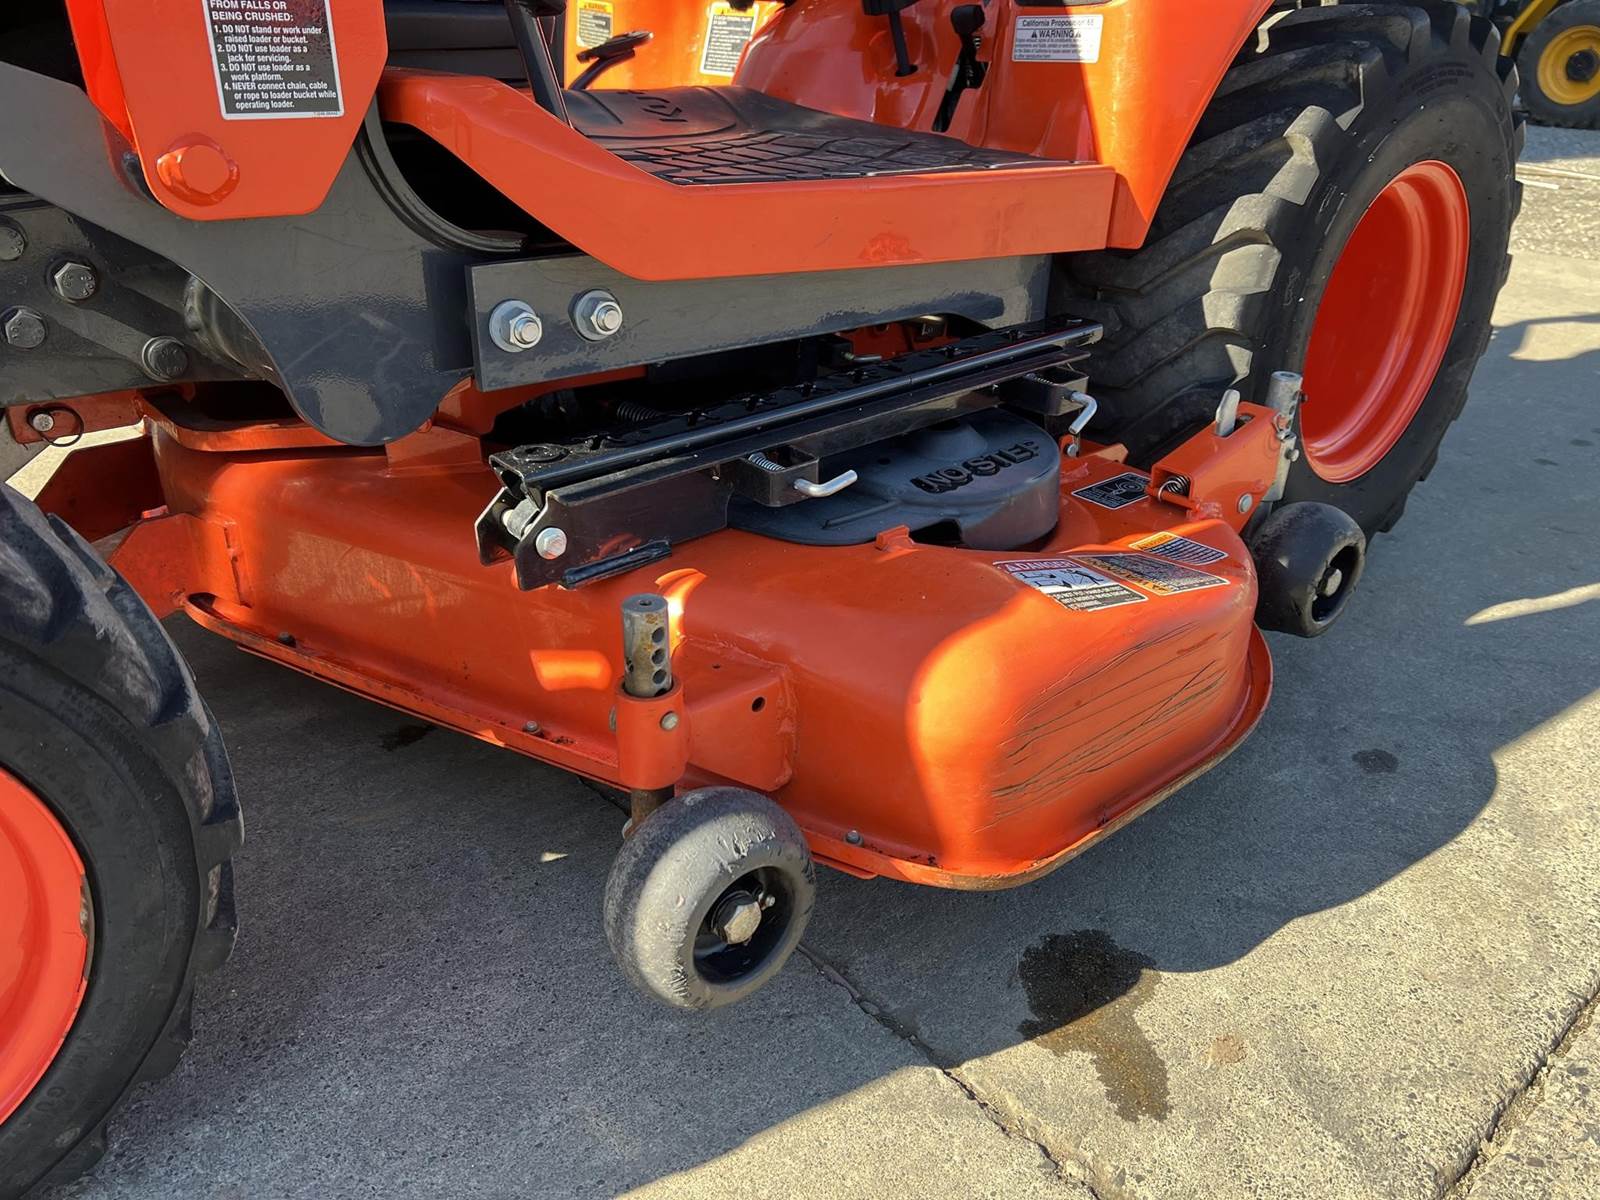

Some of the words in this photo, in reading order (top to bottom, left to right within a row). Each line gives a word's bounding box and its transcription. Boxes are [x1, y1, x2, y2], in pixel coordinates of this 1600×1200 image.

[210, 0, 239, 9] FROM
[240, 0, 271, 9] FALLS
[272, 0, 287, 10] OR
[211, 11, 242, 20] BEING
[244, 11, 294, 22] CRUSHED:
[1022, 19, 1050, 27] California
[222, 25, 234, 33] DO
[235, 25, 250, 33] NOT
[251, 25, 272, 34] stand
[282, 26, 301, 34] work
[302, 26, 322, 34] under
[1040, 29, 1074, 38] WARNING
[224, 35, 247, 43] raised
[248, 35, 272, 43] loader
[282, 35, 309, 44] bucket.
[225, 44, 237, 52] DO
[238, 44, 253, 53] NOT
[269, 44, 291, 53] loader
[227, 53, 244, 63] jack
[244, 53, 256, 62] for
[256, 53, 292, 64] servicing.
[229, 63, 240, 71] DO
[241, 63, 256, 71] NOT
[271, 63, 295, 71] loader
[230, 72, 250, 80] work
[251, 72, 284, 81] platform.
[232, 82, 256, 90] NEVER
[257, 82, 286, 90] connect
[287, 81, 308, 90] chain,
[309, 81, 328, 90] cable
[234, 92, 242, 100] or
[243, 92, 260, 101] rope
[261, 91, 269, 99] to
[270, 91, 292, 99] loader
[293, 91, 317, 99] bucket
[318, 90, 337, 98] while
[235, 101, 270, 110] operating
[270, 100, 295, 108] loader.
[910, 467, 974, 494] NO
[1016, 560, 1078, 571] DANGER
